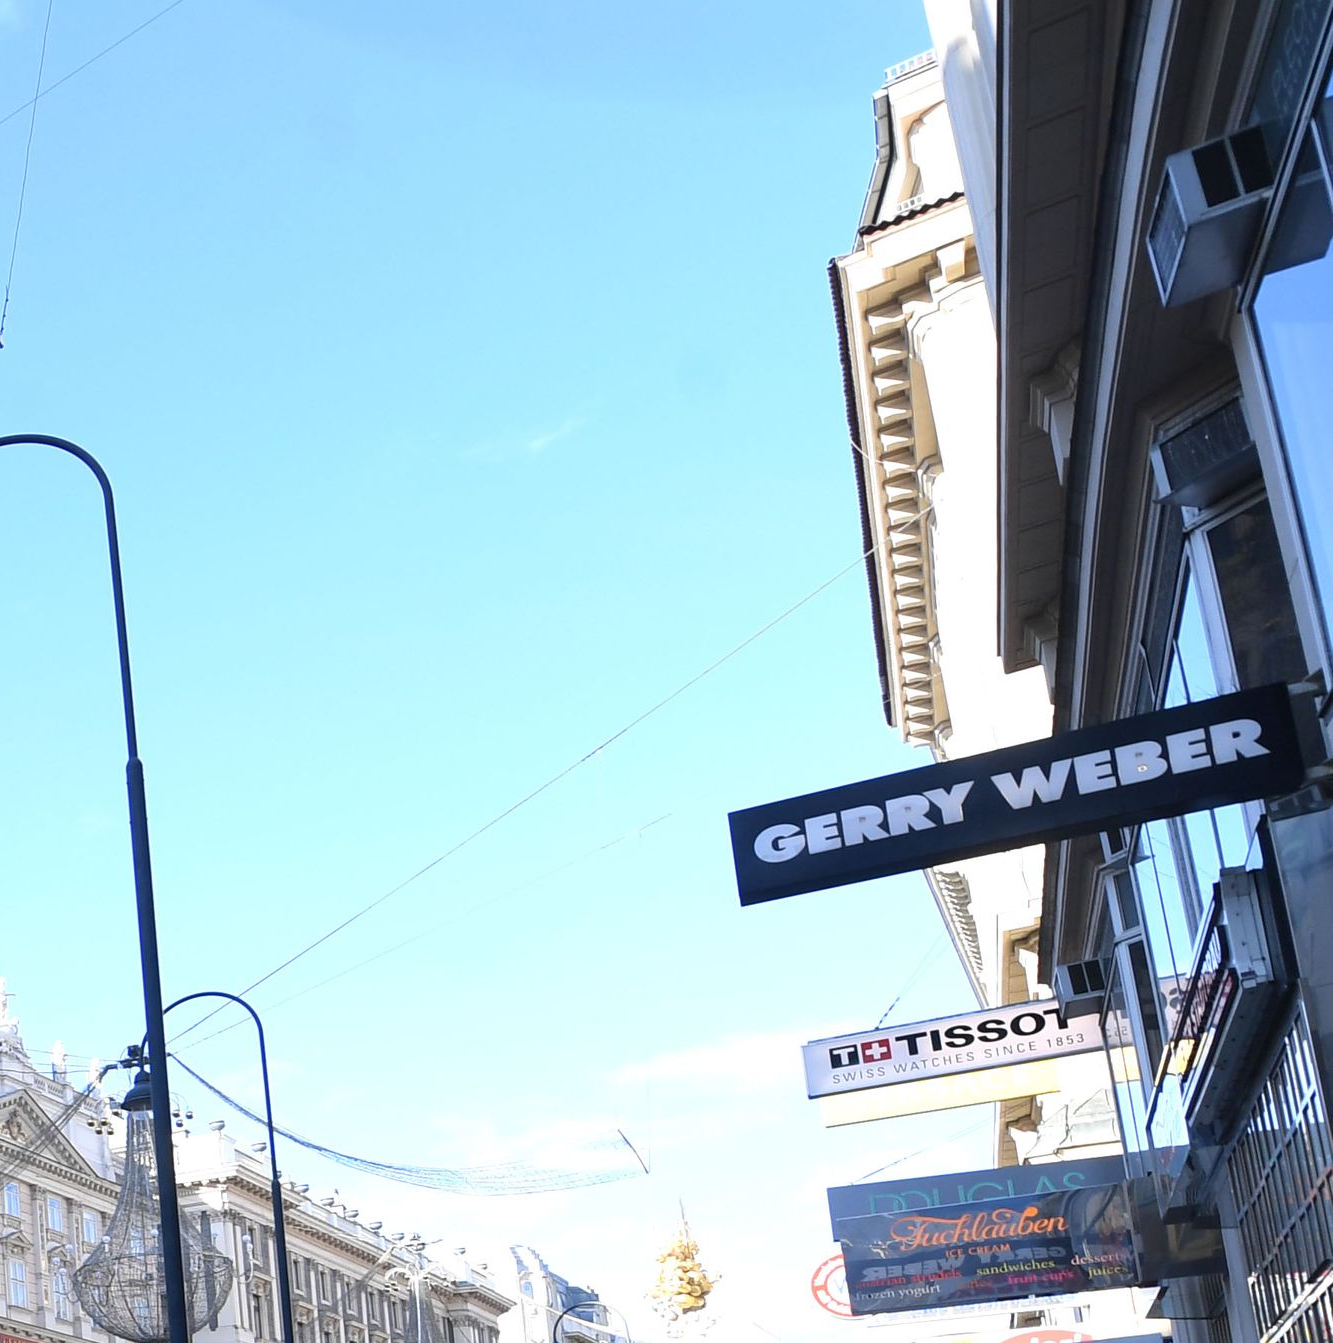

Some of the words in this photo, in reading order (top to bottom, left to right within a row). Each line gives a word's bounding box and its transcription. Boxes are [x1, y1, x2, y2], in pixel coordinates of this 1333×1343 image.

[753, 780, 975, 864] GERRY
[990, 718, 1271, 810] WEBER
[894, 1008, 1071, 1056] TISSOT
[832, 1066, 886, 1085] SWISS
[893, 1051, 975, 1074] WATCHES
[984, 1041, 1037, 1060] SINCE
[1046, 1033, 1086, 1049] 1853
[945, 1247, 967, 1259] ICE
[968, 1243, 1012, 1256] CREAM
[976, 1258, 1056, 1276] sandwiches
[1088, 1265, 1129, 1279] juices
[898, 1284, 941, 1299] yogurt
